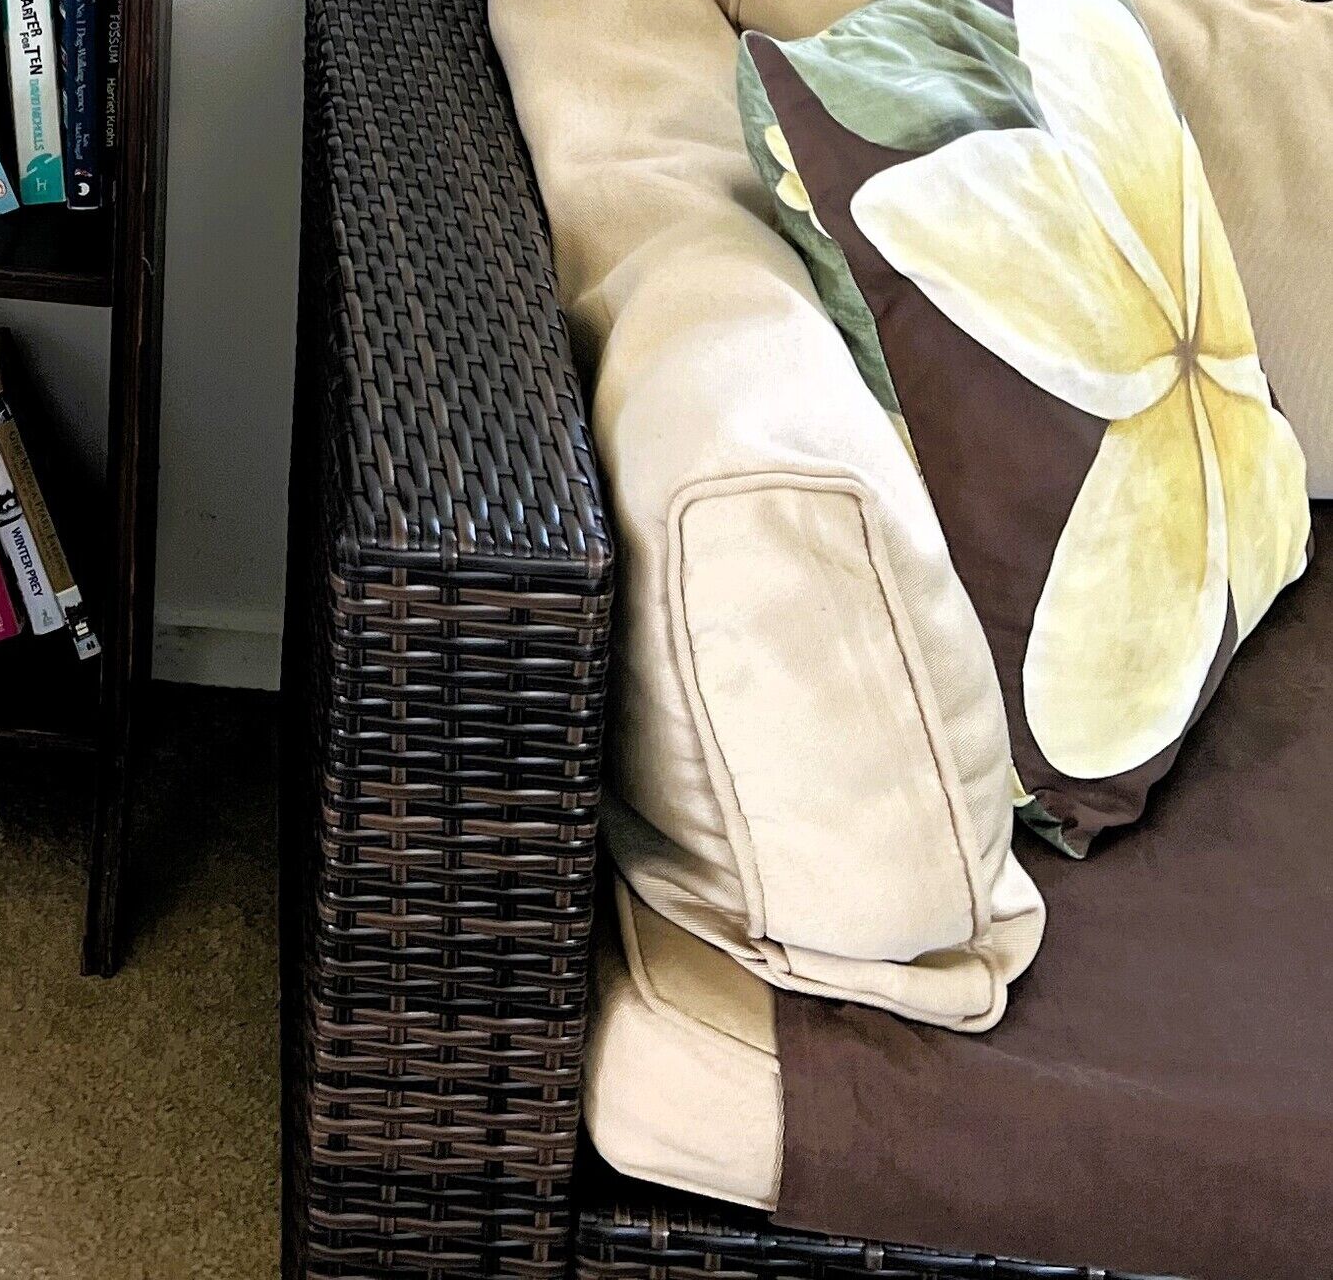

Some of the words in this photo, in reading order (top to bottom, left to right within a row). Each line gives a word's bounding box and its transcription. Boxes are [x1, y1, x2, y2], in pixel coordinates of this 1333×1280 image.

[19, 31, 31, 51] FOR
[108, 13, 119, 64] FOSSUM
[23, 44, 43, 76] TEN
[105, 113, 116, 148] Krohn
[11, 526, 36, 571] WINTER
[25, 566, 44, 597] PREY
